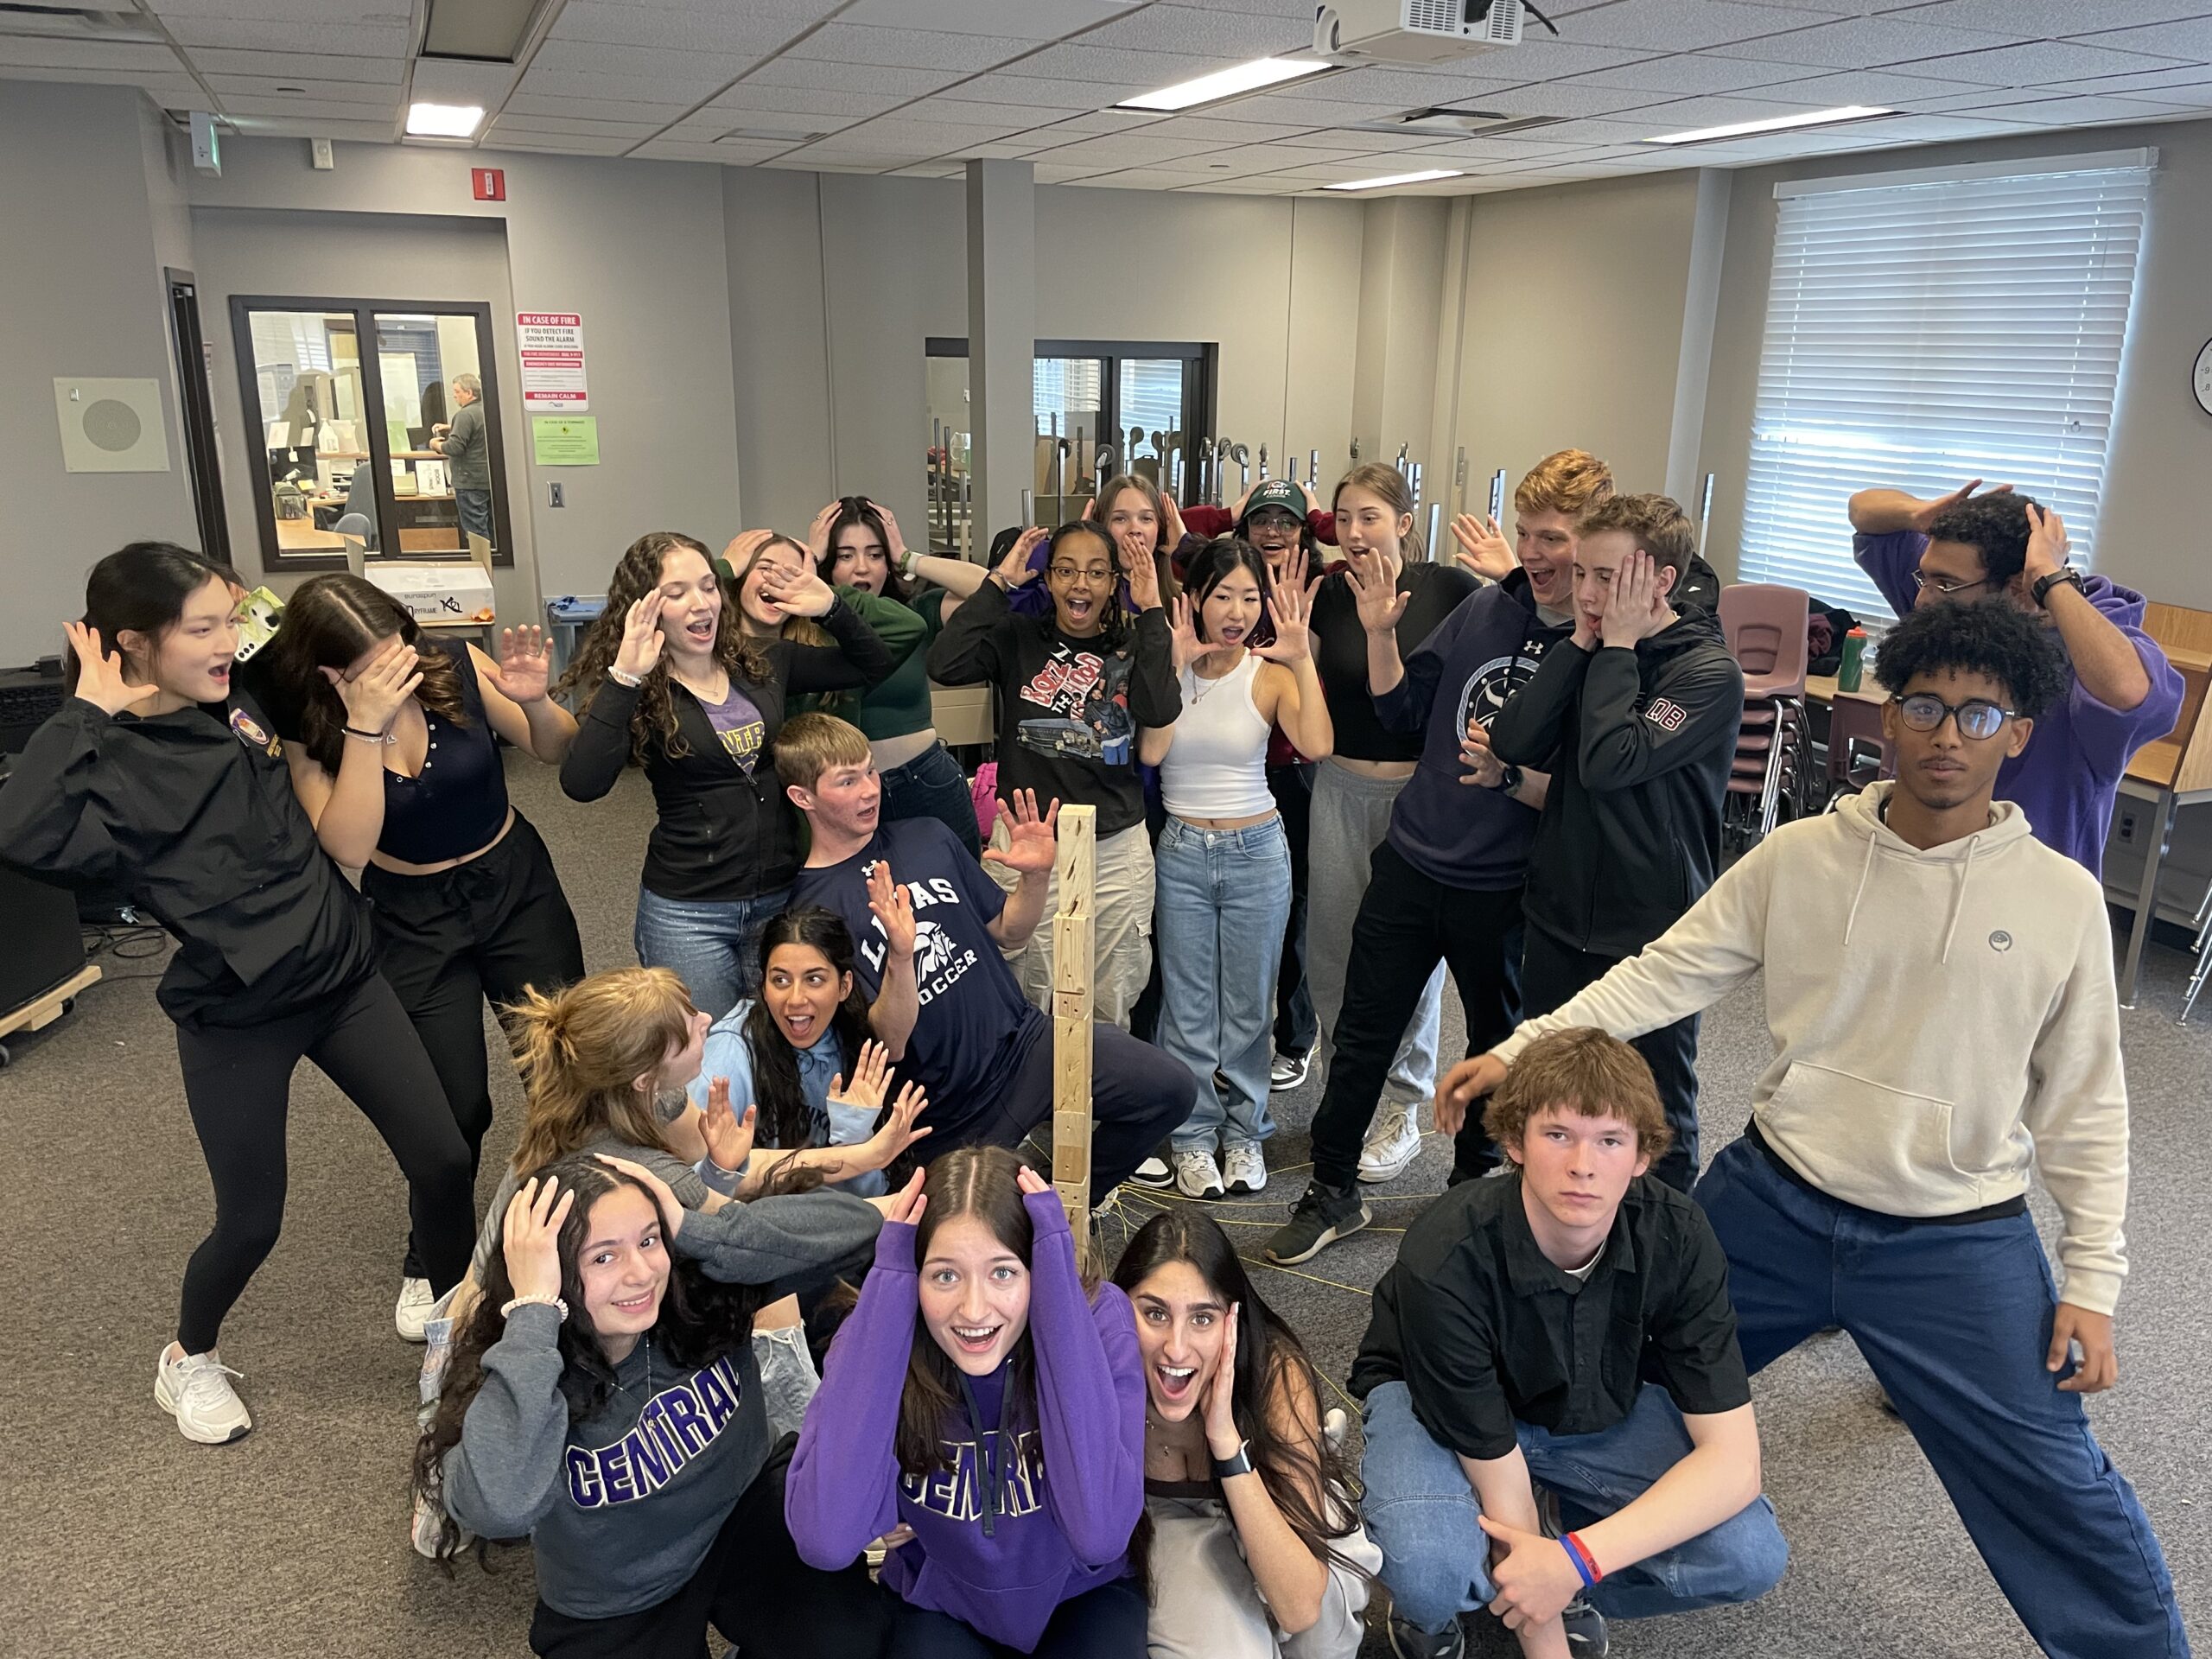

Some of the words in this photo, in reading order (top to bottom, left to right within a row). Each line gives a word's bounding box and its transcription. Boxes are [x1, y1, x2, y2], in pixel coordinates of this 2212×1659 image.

[523, 315, 531, 324] IN
[532, 315, 550, 325] CASE
[550, 316, 560, 325] OF
[561, 316, 576, 325] FIRE
[2204, 383, 2211, 391] 8
[1051, 693, 1073, 714] THE
[1645, 697, 1687, 731] QB
[861, 878, 960, 973] LAS
[918, 950, 977, 1006] OCCER
[566, 1355, 742, 1508] CENTRAL
